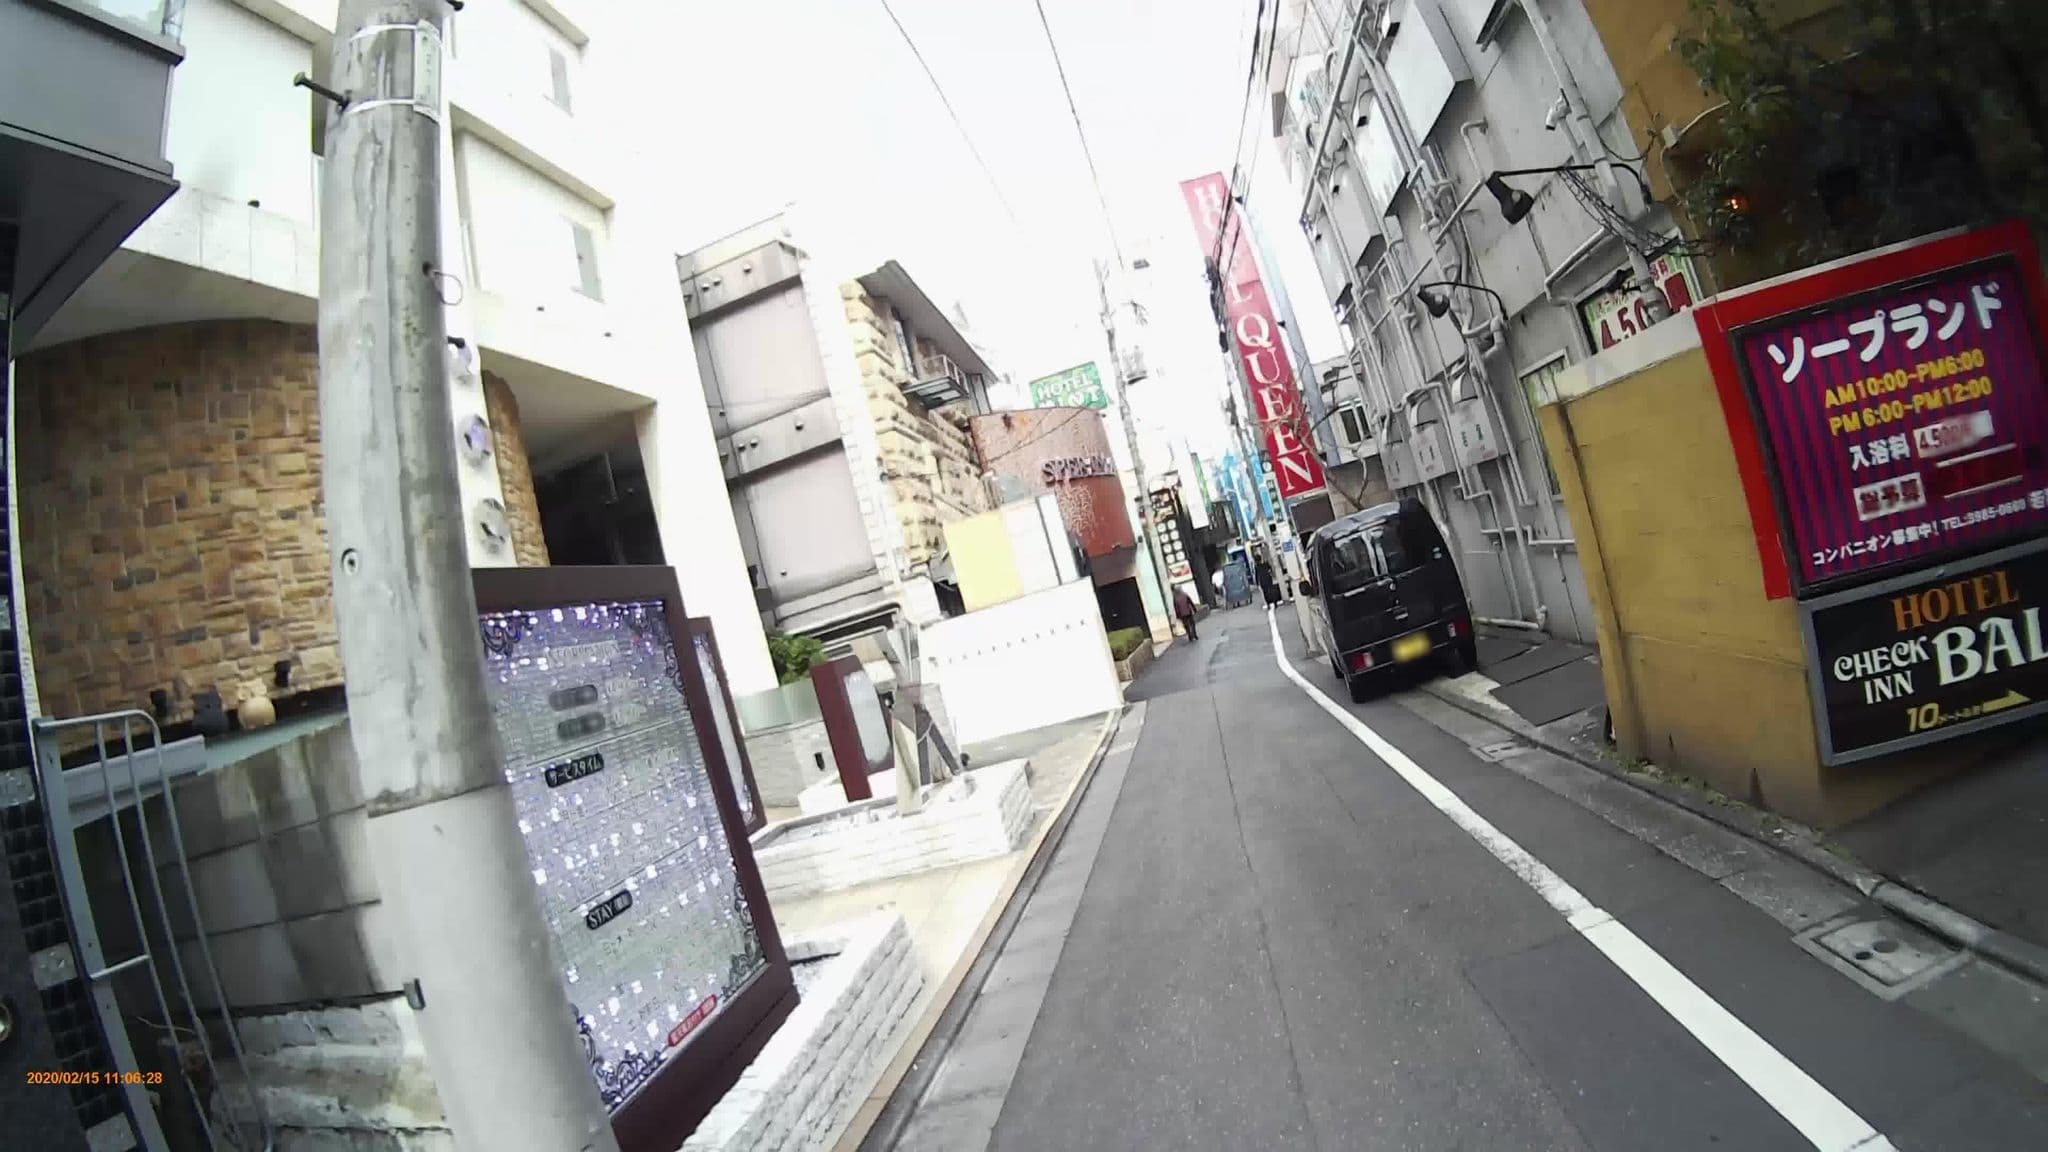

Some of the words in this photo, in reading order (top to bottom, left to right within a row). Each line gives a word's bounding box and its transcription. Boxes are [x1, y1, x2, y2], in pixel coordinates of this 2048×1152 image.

[1767, 281, 2002, 384] ソープランド
[1037, 373, 1093, 401] HOTEL
[1237, 312, 1317, 491] QUEEN
[1892, 569, 2019, 631] HOTEL
[1833, 636, 1930, 682] CHECK
[1863, 670, 1915, 704] INN
